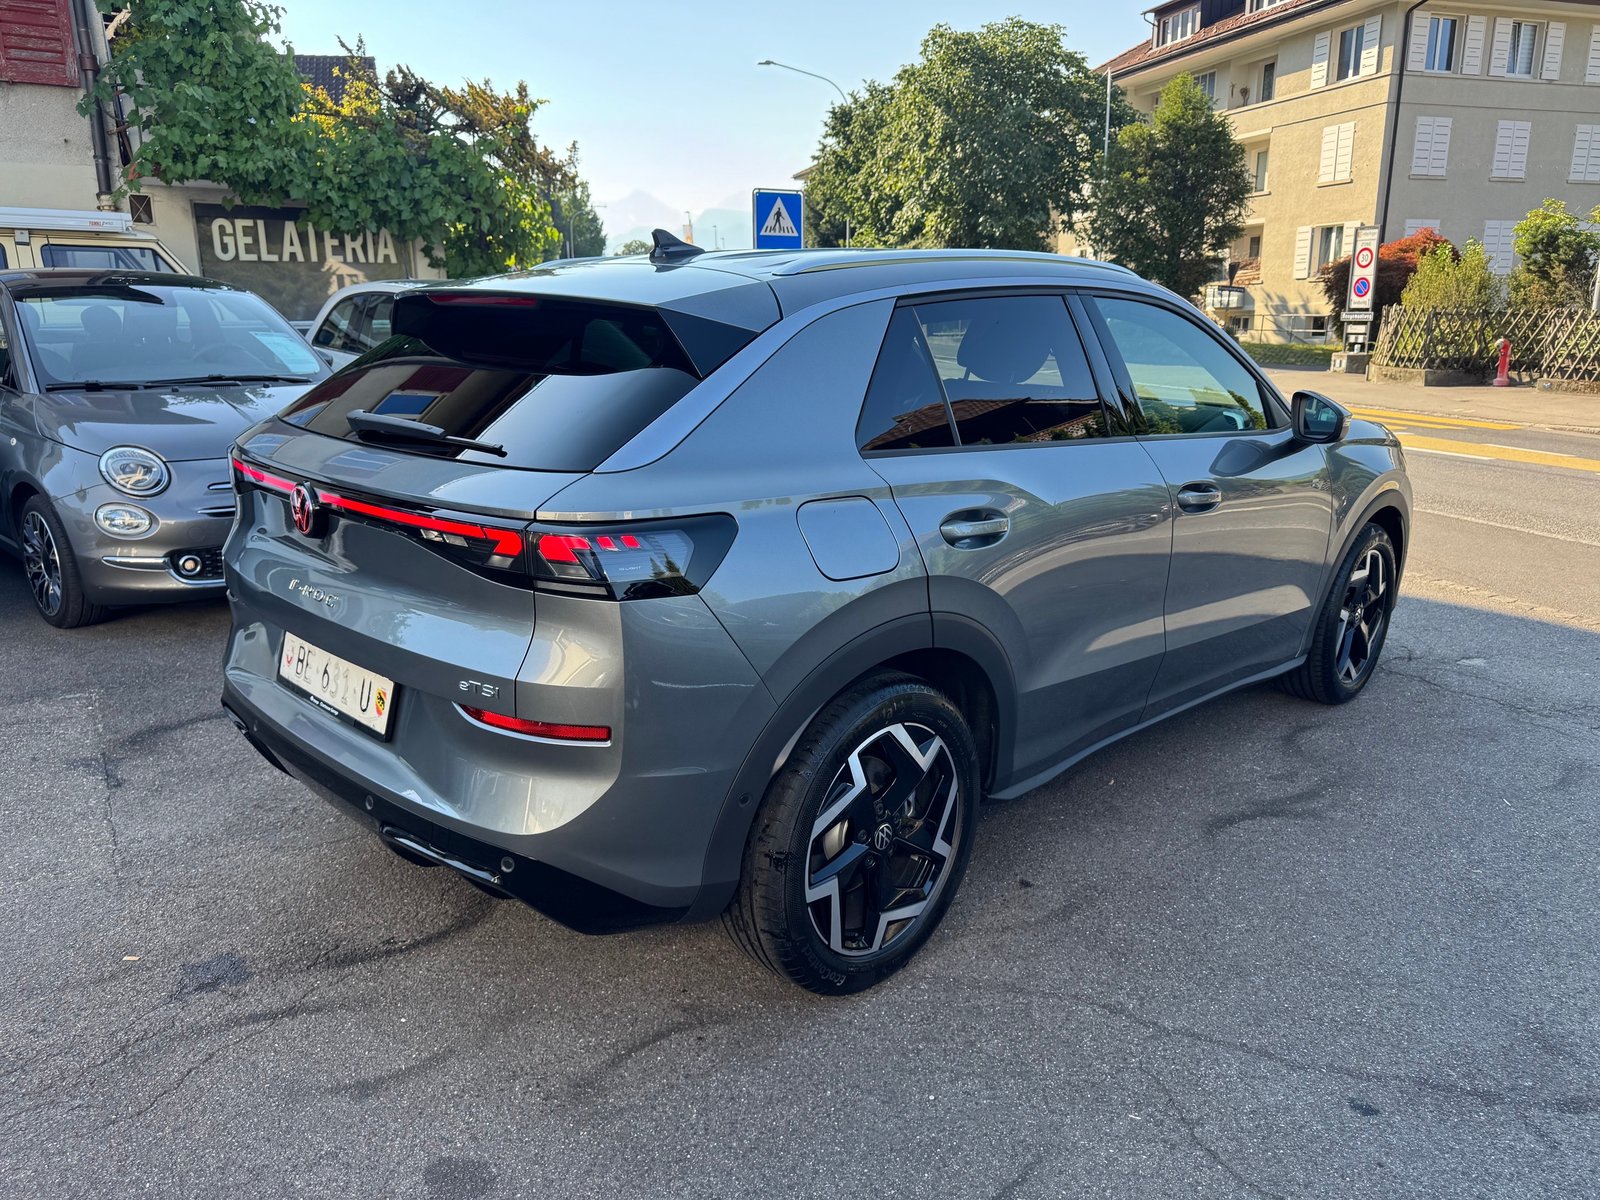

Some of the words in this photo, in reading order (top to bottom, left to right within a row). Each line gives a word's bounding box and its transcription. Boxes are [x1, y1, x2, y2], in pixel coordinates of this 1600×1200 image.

[211, 217, 398, 264] GELATERIA
[1361, 253, 1369, 262] 30
[360, 678, 372, 712] U
